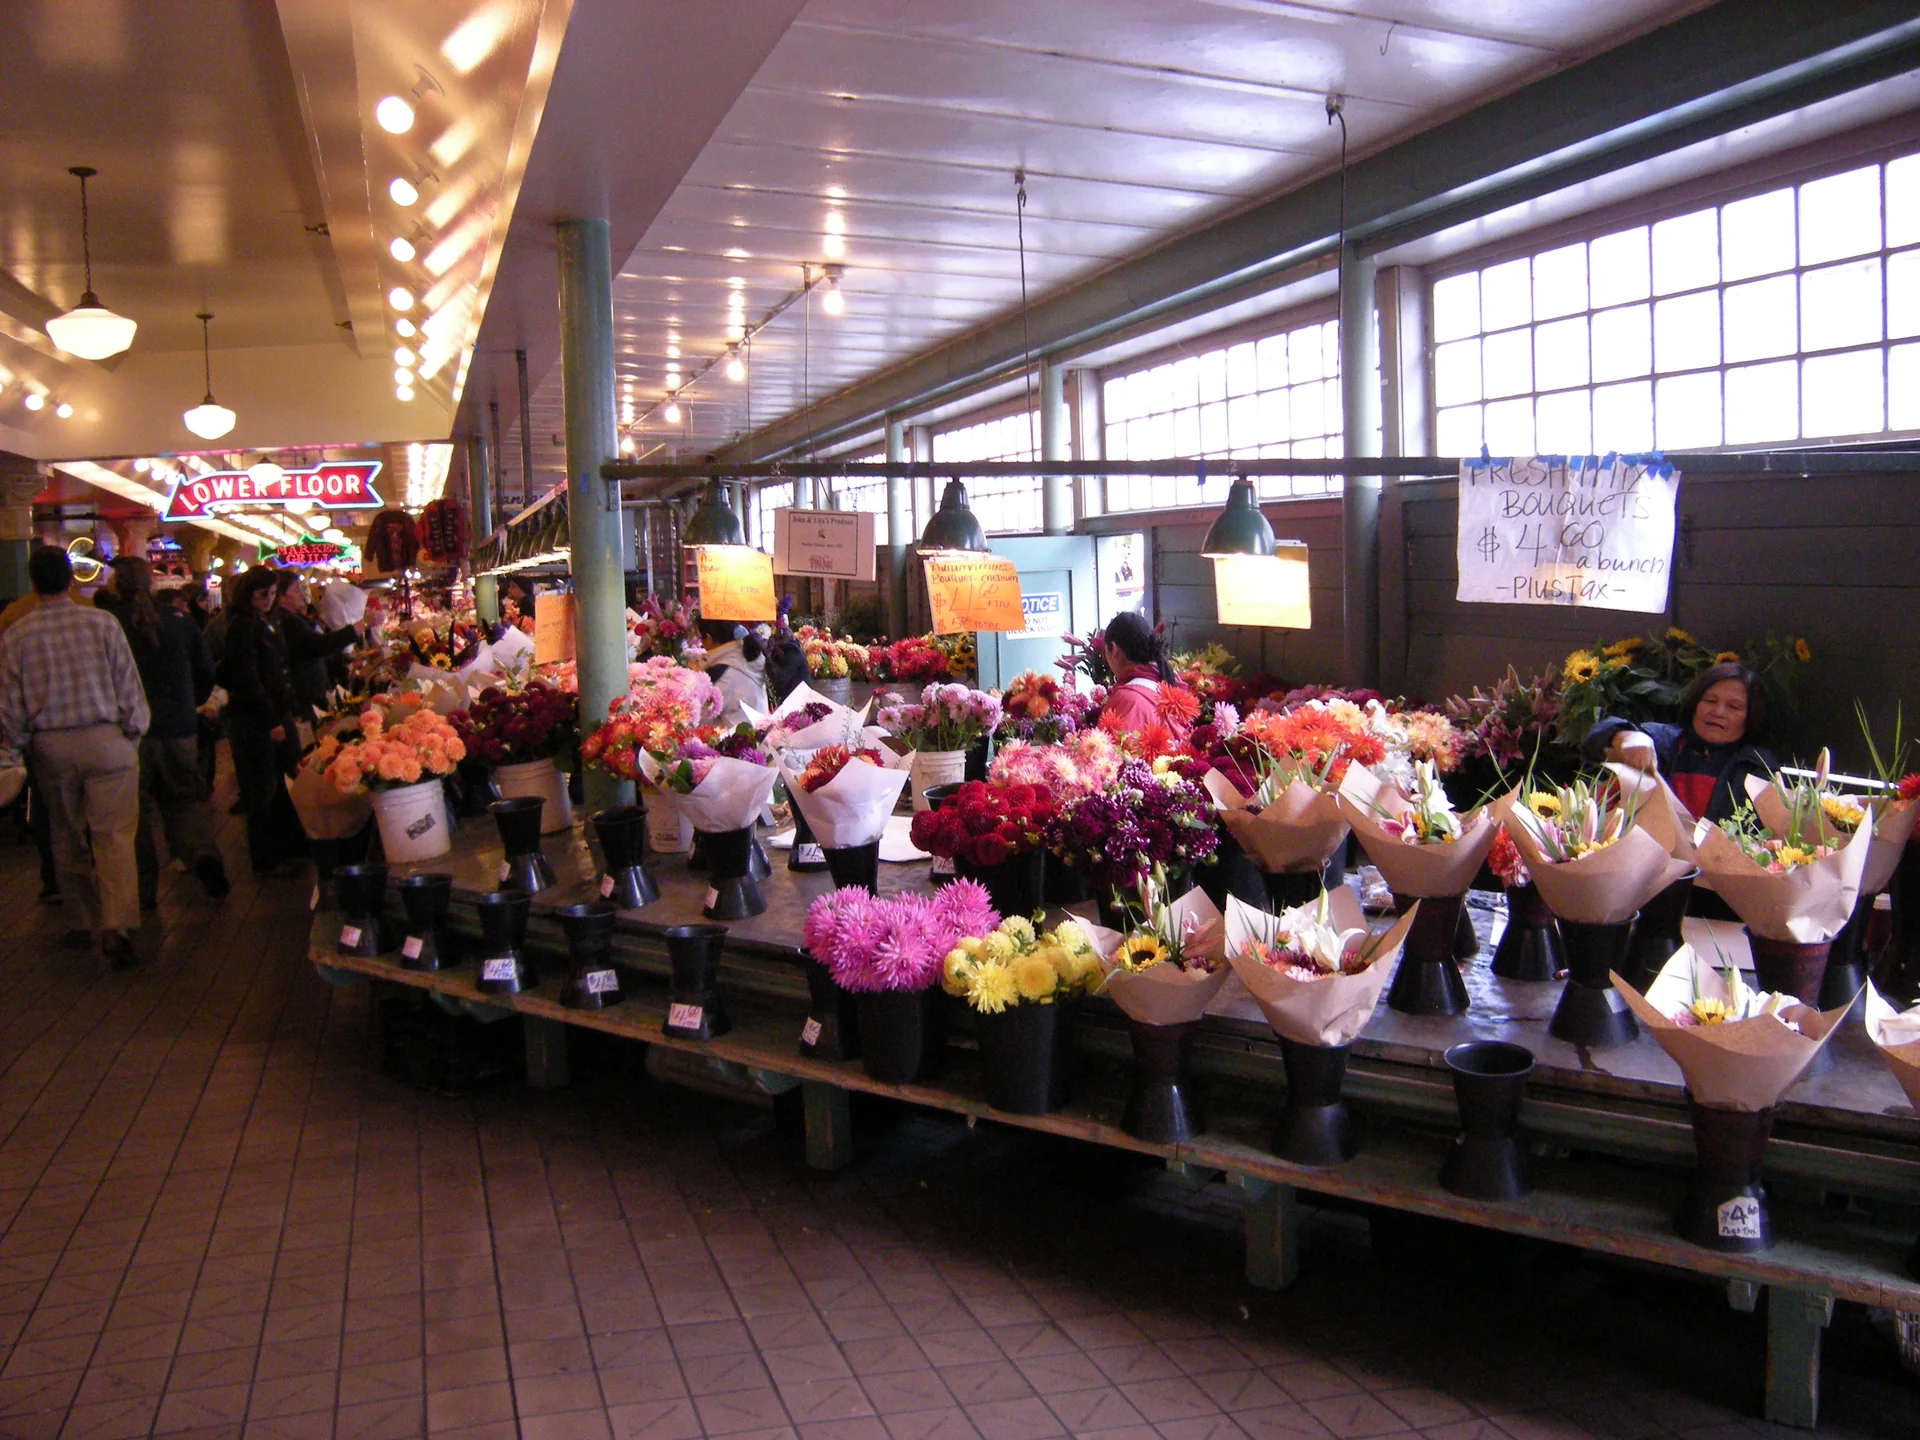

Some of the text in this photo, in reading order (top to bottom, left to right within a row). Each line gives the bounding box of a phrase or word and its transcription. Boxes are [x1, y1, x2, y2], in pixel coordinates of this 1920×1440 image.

[179, 474, 361, 513] LOWER FLOOR
[276, 543, 340, 555] MARKET
[1576, 551, 1665, 574] a bunch
[1021, 596, 1058, 613] OTICE
